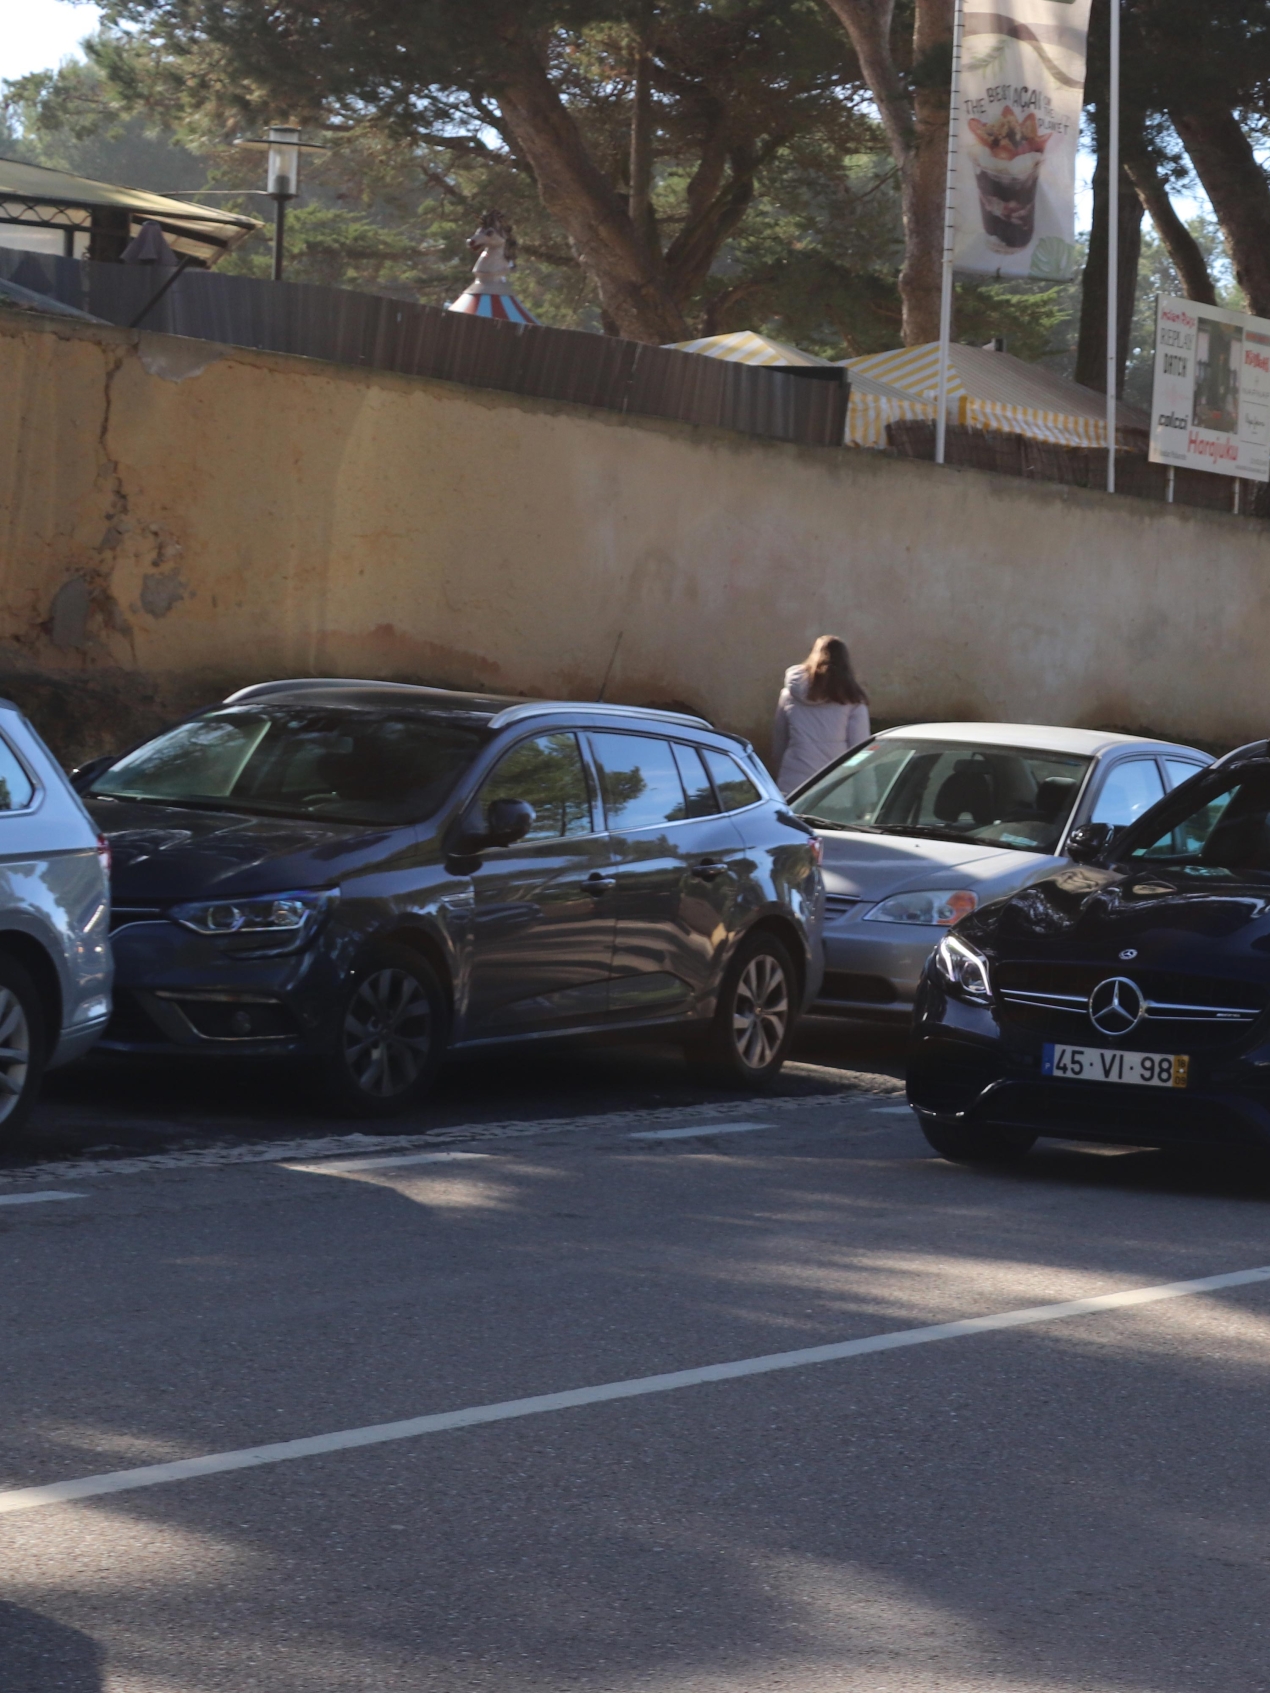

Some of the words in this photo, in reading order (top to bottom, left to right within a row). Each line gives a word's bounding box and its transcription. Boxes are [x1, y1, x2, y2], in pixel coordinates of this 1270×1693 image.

[964, 98, 986, 115] THE
[986, 84, 1012, 103] BEST
[1038, 118, 1070, 135] PLANET
[1187, 429, 1239, 465] Harajuku
